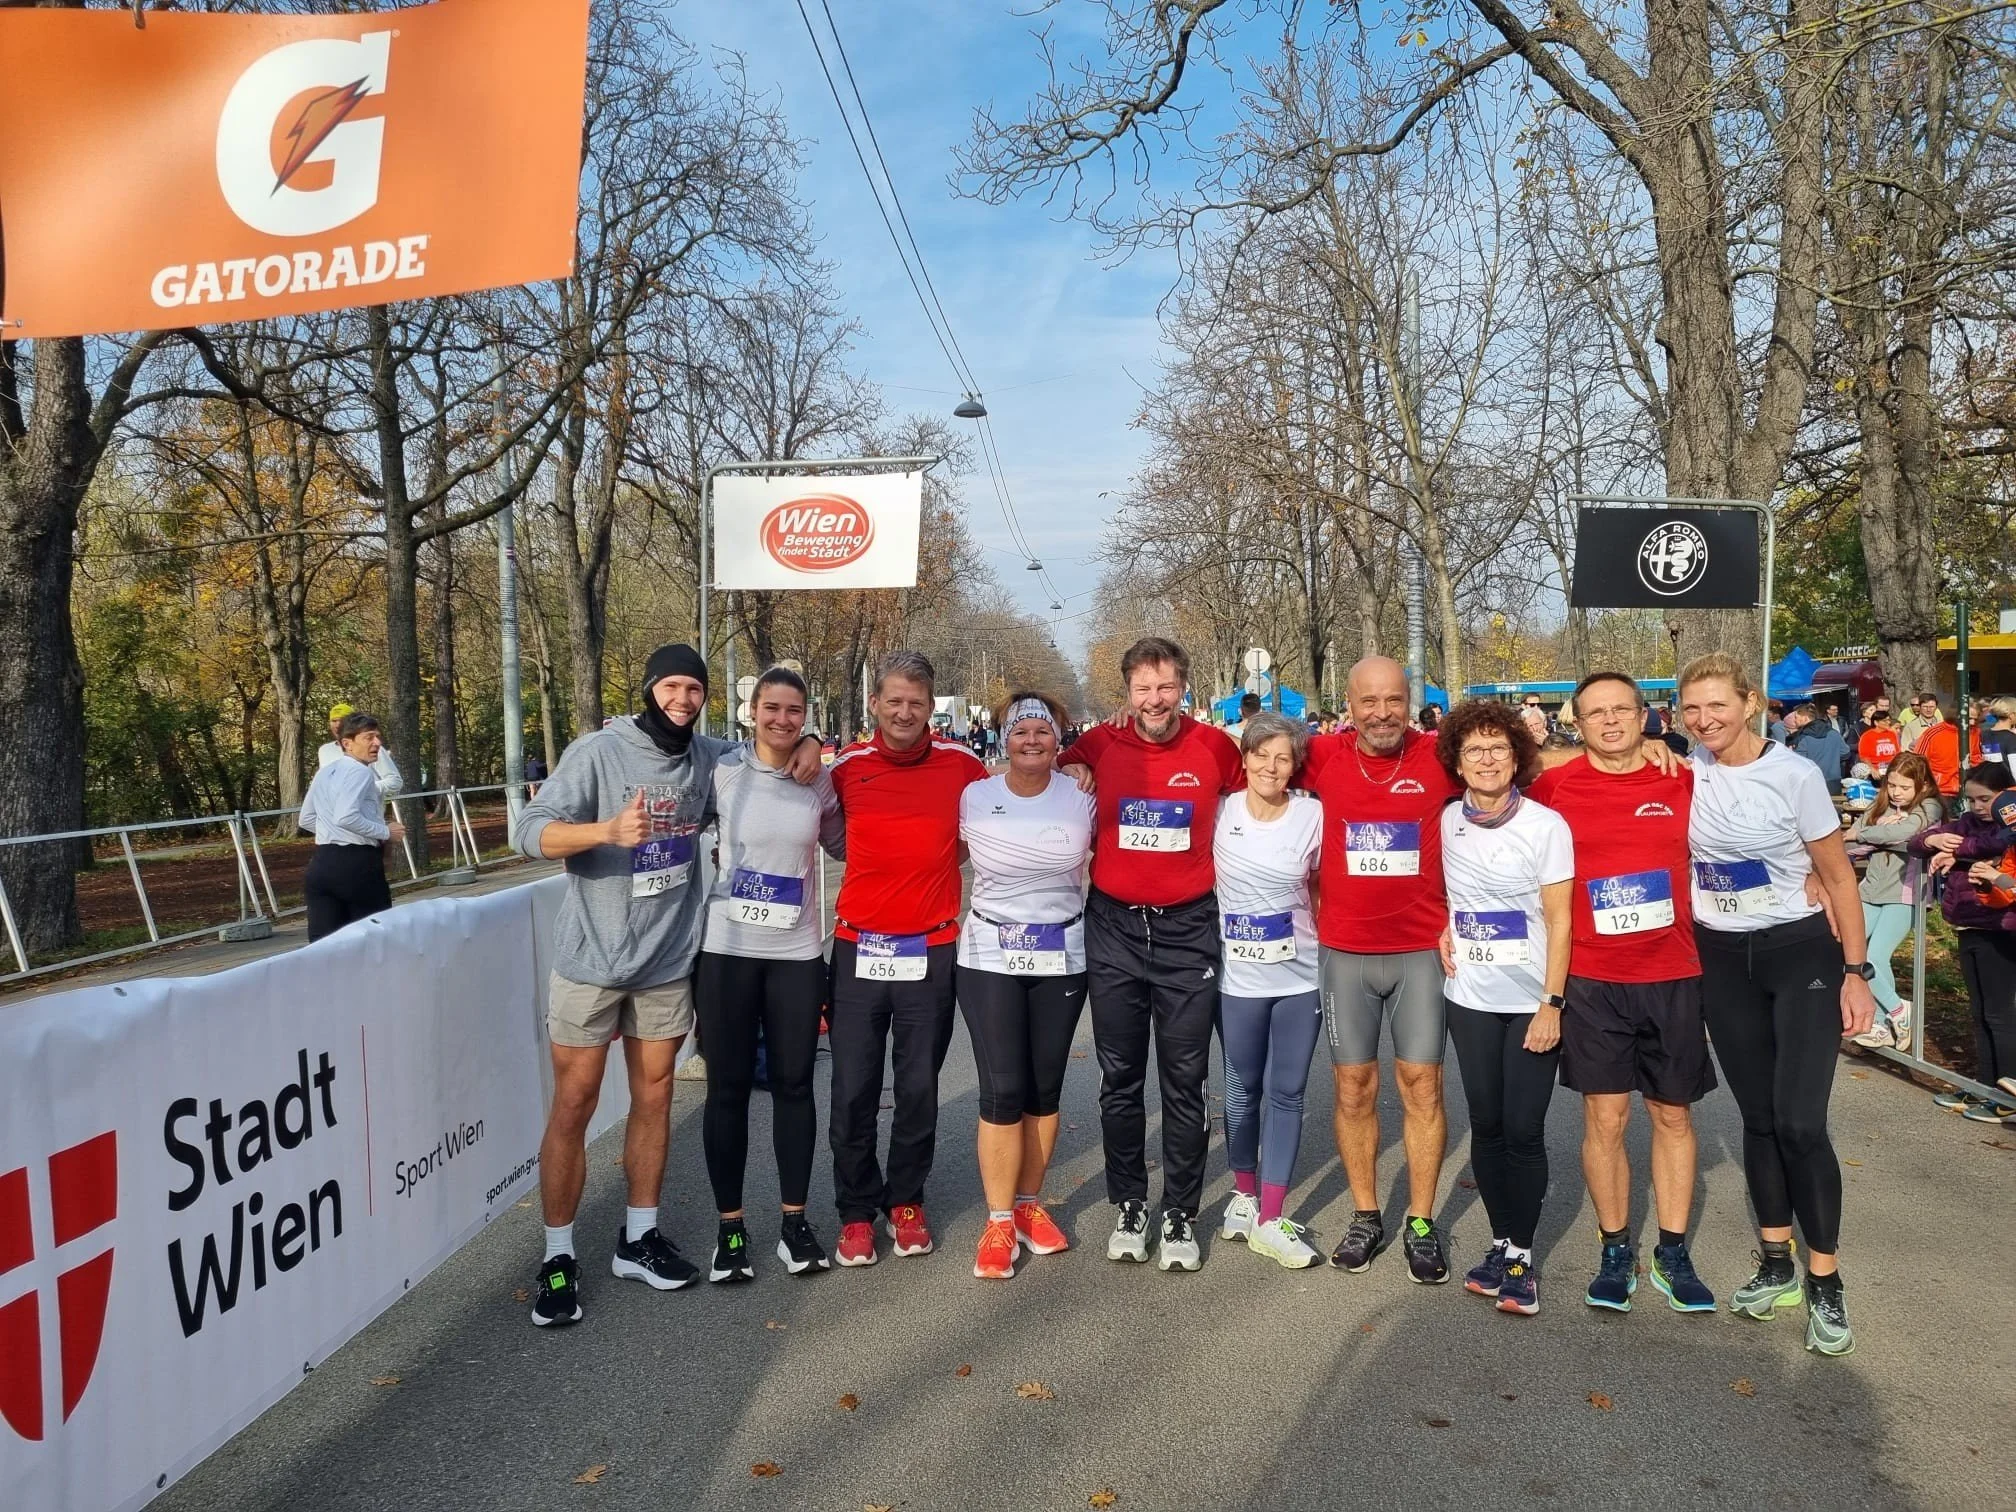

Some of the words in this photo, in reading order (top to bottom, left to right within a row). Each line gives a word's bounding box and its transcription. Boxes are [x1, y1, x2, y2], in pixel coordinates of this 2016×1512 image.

[215, 30, 391, 236] G
[151, 235, 427, 308] GATORADE
[779, 508, 856, 533] Wien
[784, 534, 862, 548] Bewegung
[1642, 529, 1667, 558] ALFA
[1673, 525, 1704, 560] ROMEO
[778, 547, 807, 556] findet
[808, 546, 850, 558] Stadt
[1131, 833, 1159, 847] 242
[1360, 857, 1388, 871] 686
[648, 875, 671, 891] 739
[742, 905, 769, 921] 739
[1715, 898, 1738, 912] 129
[1611, 912, 1640, 930] 129
[1239, 946, 1265, 960] 242
[1469, 947, 1494, 961] 686
[869, 963, 896, 977] 656
[1009, 957, 1035, 970] 656
[164, 1048, 338, 1212] Stadt
[395, 1142, 443, 1199] Sport
[445, 1119, 484, 1160] Wien
[486, 1152, 542, 1206] sport.wien.gv.a
[167, 1179, 343, 1338] Wien
